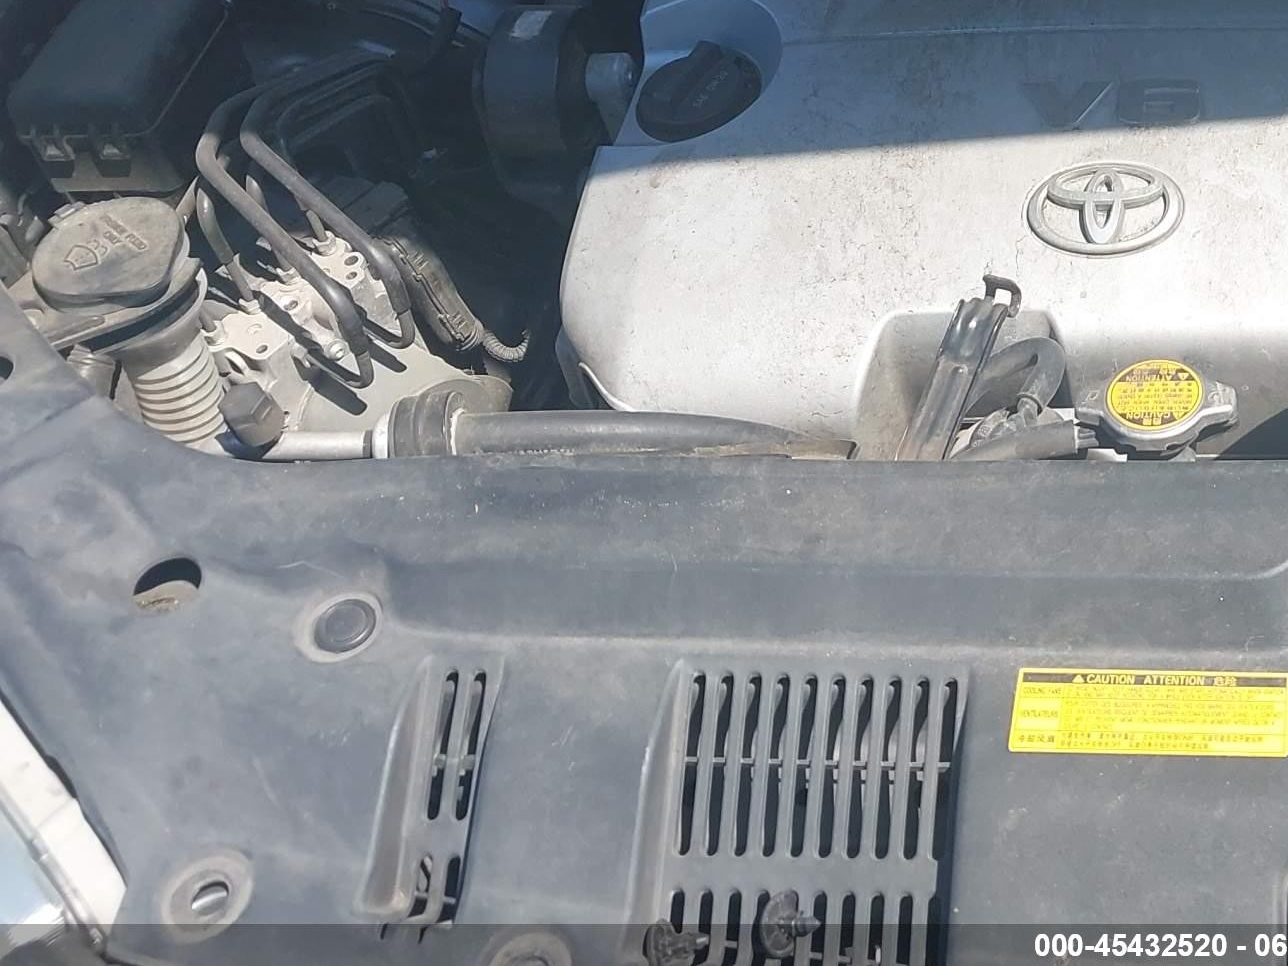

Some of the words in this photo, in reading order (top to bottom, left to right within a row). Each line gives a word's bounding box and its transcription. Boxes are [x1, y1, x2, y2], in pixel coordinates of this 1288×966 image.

[1022, 80, 1201, 129] V6
[1126, 411, 1171, 419] CAUTION
[1087, 674, 1135, 685] CAUTION
[1144, 675, 1205, 686] ATTENTION
